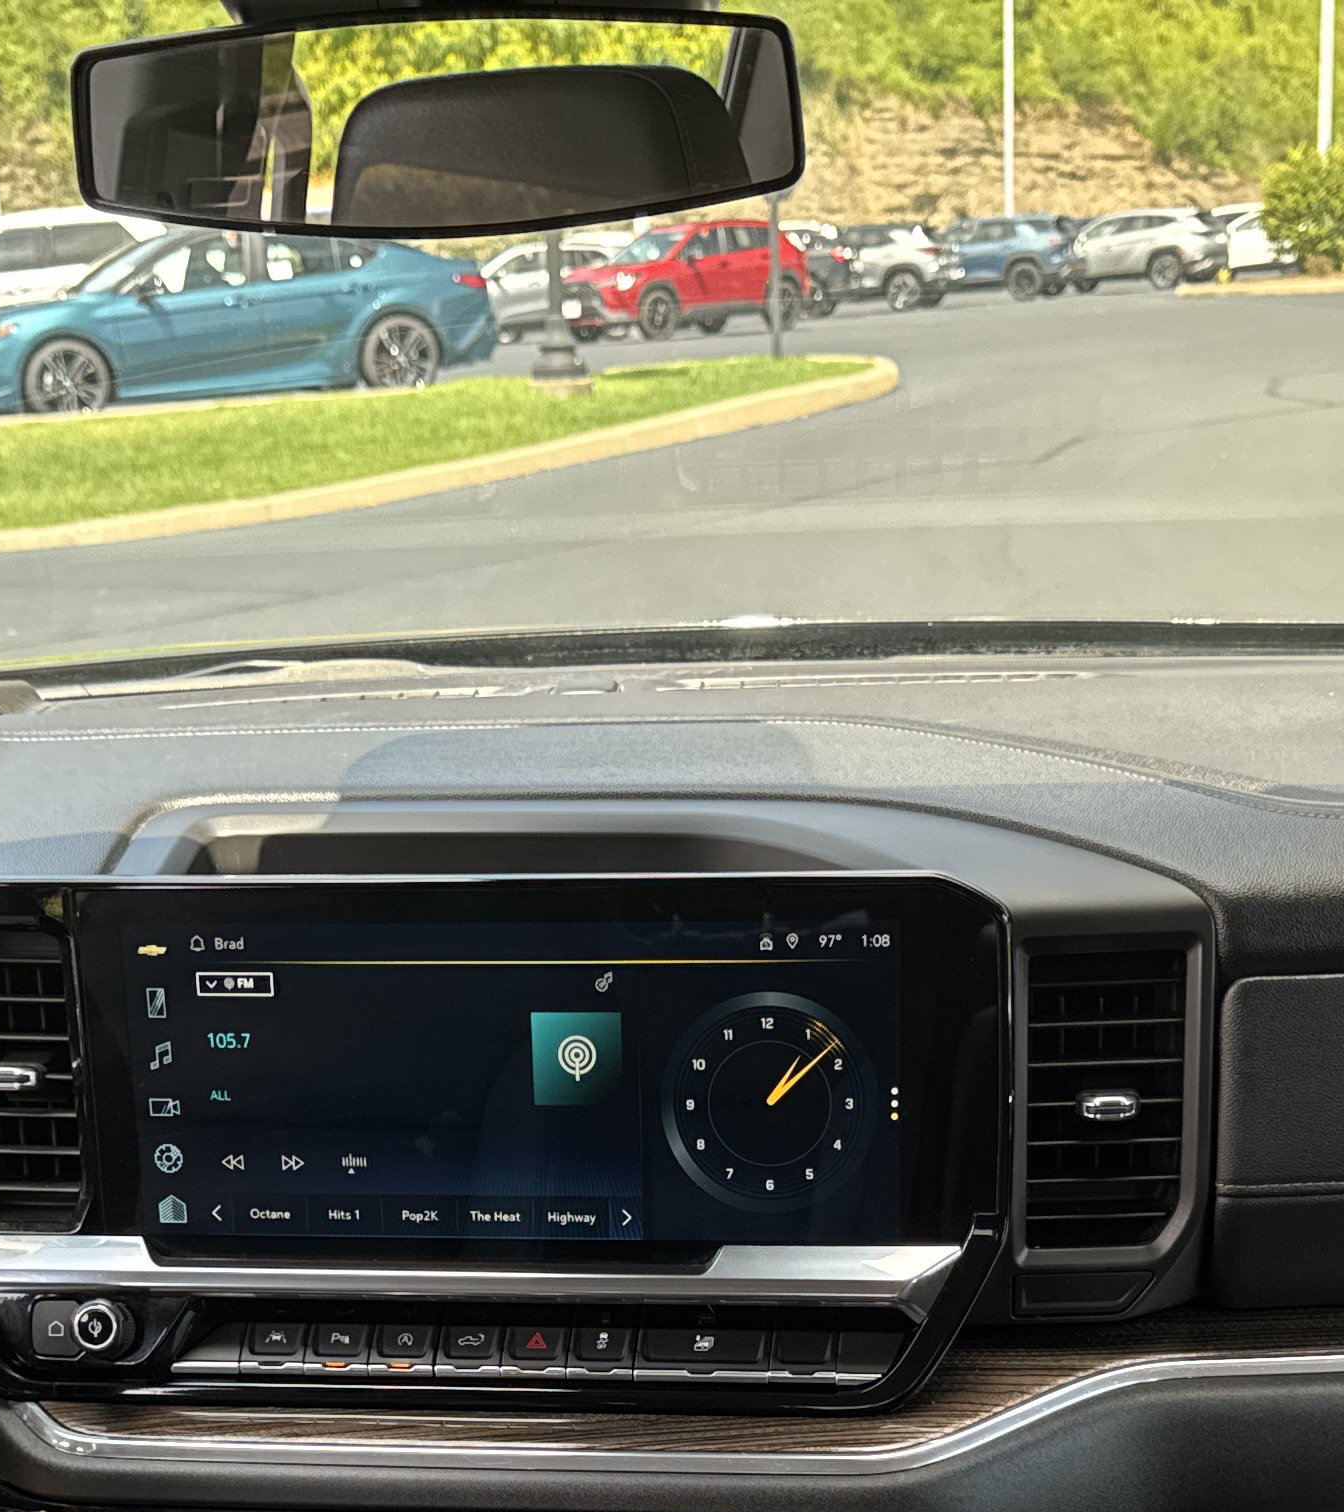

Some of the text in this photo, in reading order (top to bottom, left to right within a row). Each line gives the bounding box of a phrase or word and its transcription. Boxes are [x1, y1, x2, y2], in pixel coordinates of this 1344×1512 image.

[214, 936, 244, 950] Brad
[861, 934, 891, 948] 1:08
[237, 977, 254, 989] FM
[760, 1017, 774, 1030] 12
[207, 1032, 251, 1049] 105.7
[723, 1029, 734, 1041] 11
[805, 1028, 812, 1041] 1
[692, 1058, 706, 1071] 10
[834, 1058, 843, 1071] 2
[209, 1090, 232, 1102] ALL
[685, 1099, 695, 1111] 9
[844, 1098, 854, 1110] 3
[696, 1138, 706, 1151] 8
[833, 1139, 842, 1151] 4
[726, 1168, 734, 1179] 7
[805, 1168, 814, 1180] 5
[765, 1179, 775, 1191] 6
[250, 1208, 291, 1220] Octane
[328, 1209, 361, 1220] Hits 1
[401, 1210, 439, 1224] Pop2K
[469, 1211, 520, 1223] The Heat
[547, 1212, 596, 1226] Highway
